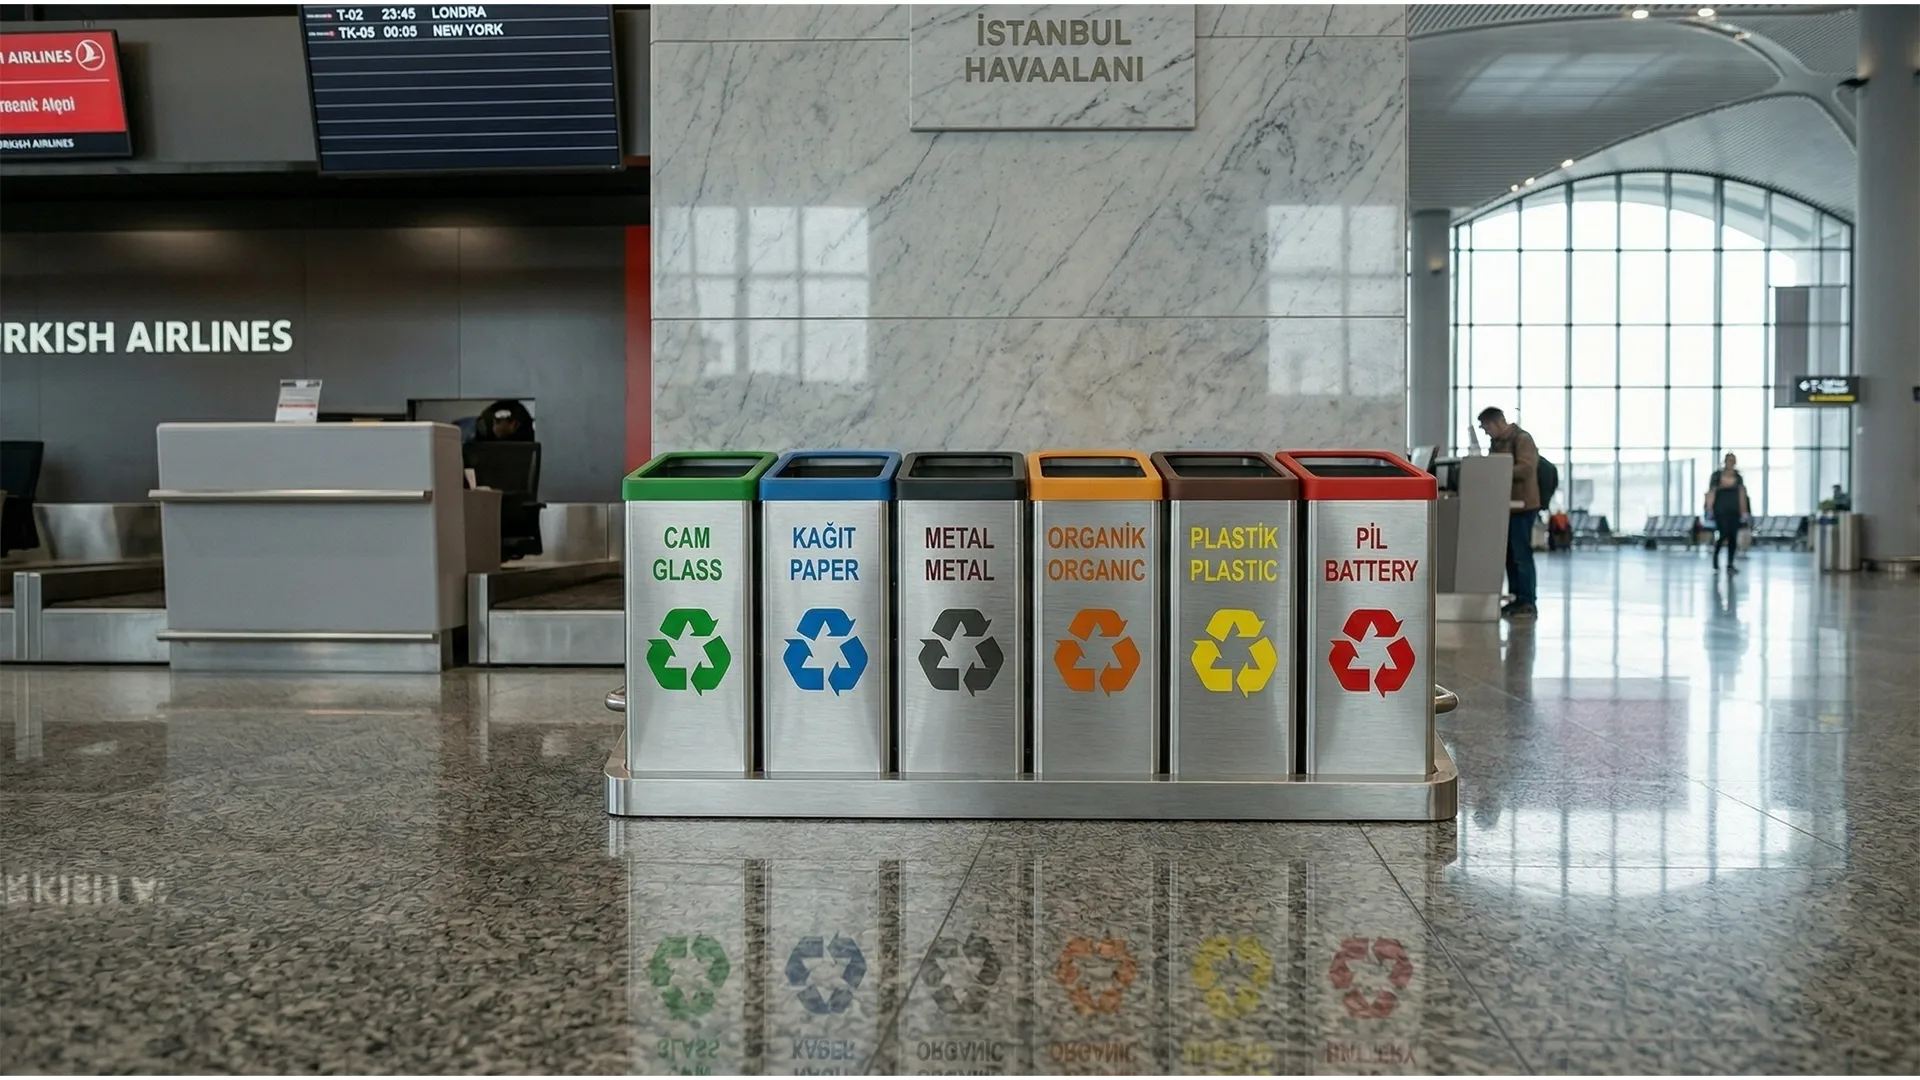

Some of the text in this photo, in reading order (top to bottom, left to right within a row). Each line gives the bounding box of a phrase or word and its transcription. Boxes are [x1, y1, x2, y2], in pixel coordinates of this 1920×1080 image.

[336, 9, 364, 21] T-02
[382, 7, 416, 20] 23:45
[431, 6, 487, 19] LONDRA
[338, 26, 375, 39] TK-05
[383, 25, 418, 38] 00:05
[433, 24, 466, 37] NEW
[466, 23, 504, 36] YORK
[977, 13, 1132, 46] İSTANBUL
[8, 50, 73, 64] AIRLINES
[965, 56, 1144, 83] HAVAALANI
[32, 138, 74, 149] AIRLINES
[0, 320, 293, 354] RKISH AIRLINES
[663, 526, 711, 549] CAM
[792, 521, 857, 549] KAĞIT
[925, 526, 995, 549] METAL
[1047, 521, 1146, 549] ORGANİK
[1190, 521, 1279, 550] PLASTİK
[1356, 522, 1388, 550] PİL
[652, 558, 723, 582] GLASS
[790, 558, 860, 581] PAPER
[925, 558, 995, 581] METAL
[1047, 558, 1146, 582] ORGANIC
[1190, 559, 1278, 582] PLASTIC
[1324, 559, 1420, 582] BATTERY
